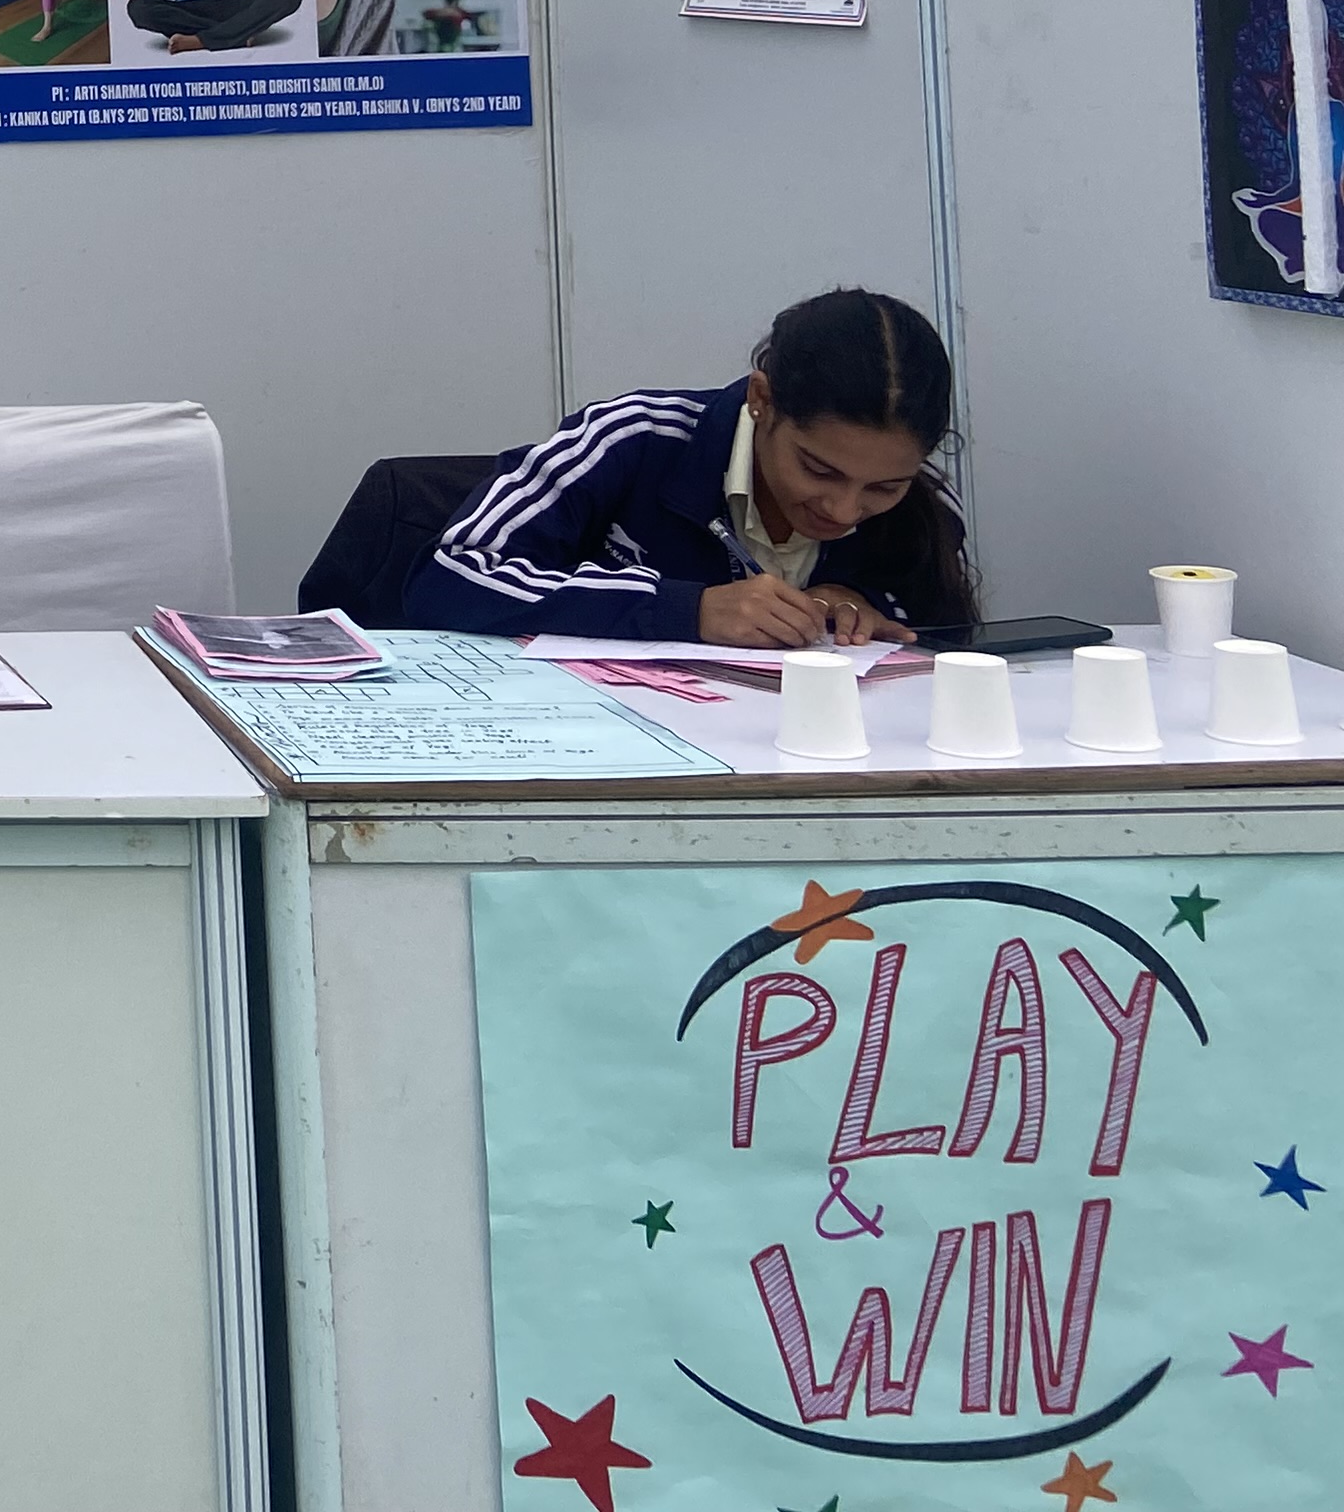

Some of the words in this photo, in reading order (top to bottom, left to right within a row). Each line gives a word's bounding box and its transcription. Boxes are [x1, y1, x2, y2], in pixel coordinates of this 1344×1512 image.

[10, 111, 49, 127] KANIKA
[51, 109, 86, 125] GUPTA
[128, 107, 149, 123] 2ND
[189, 105, 216, 121] TANU
[219, 104, 262, 120] KUMARI
[265, 102, 297, 118] (BNYS
[300, 102, 322, 117] 2ND
[362, 98, 410, 115] RASHIKA
[426, 97, 460, 113] (BNYS
[463, 96, 484, 112] 2ND
[487, 95, 521, 111] YEAR)
[74, 85, 99, 101] ARTI
[101, 84, 147, 100] SHARMA
[149, 83, 182, 99] (YOGA
[252, 80, 266, 95] DR
[313, 77, 341, 92] SAINI
[732, 938, 1158, 1177] PLAY
[814, 1166, 886, 1240] &
[749, 1197, 1111, 1424] WIN
